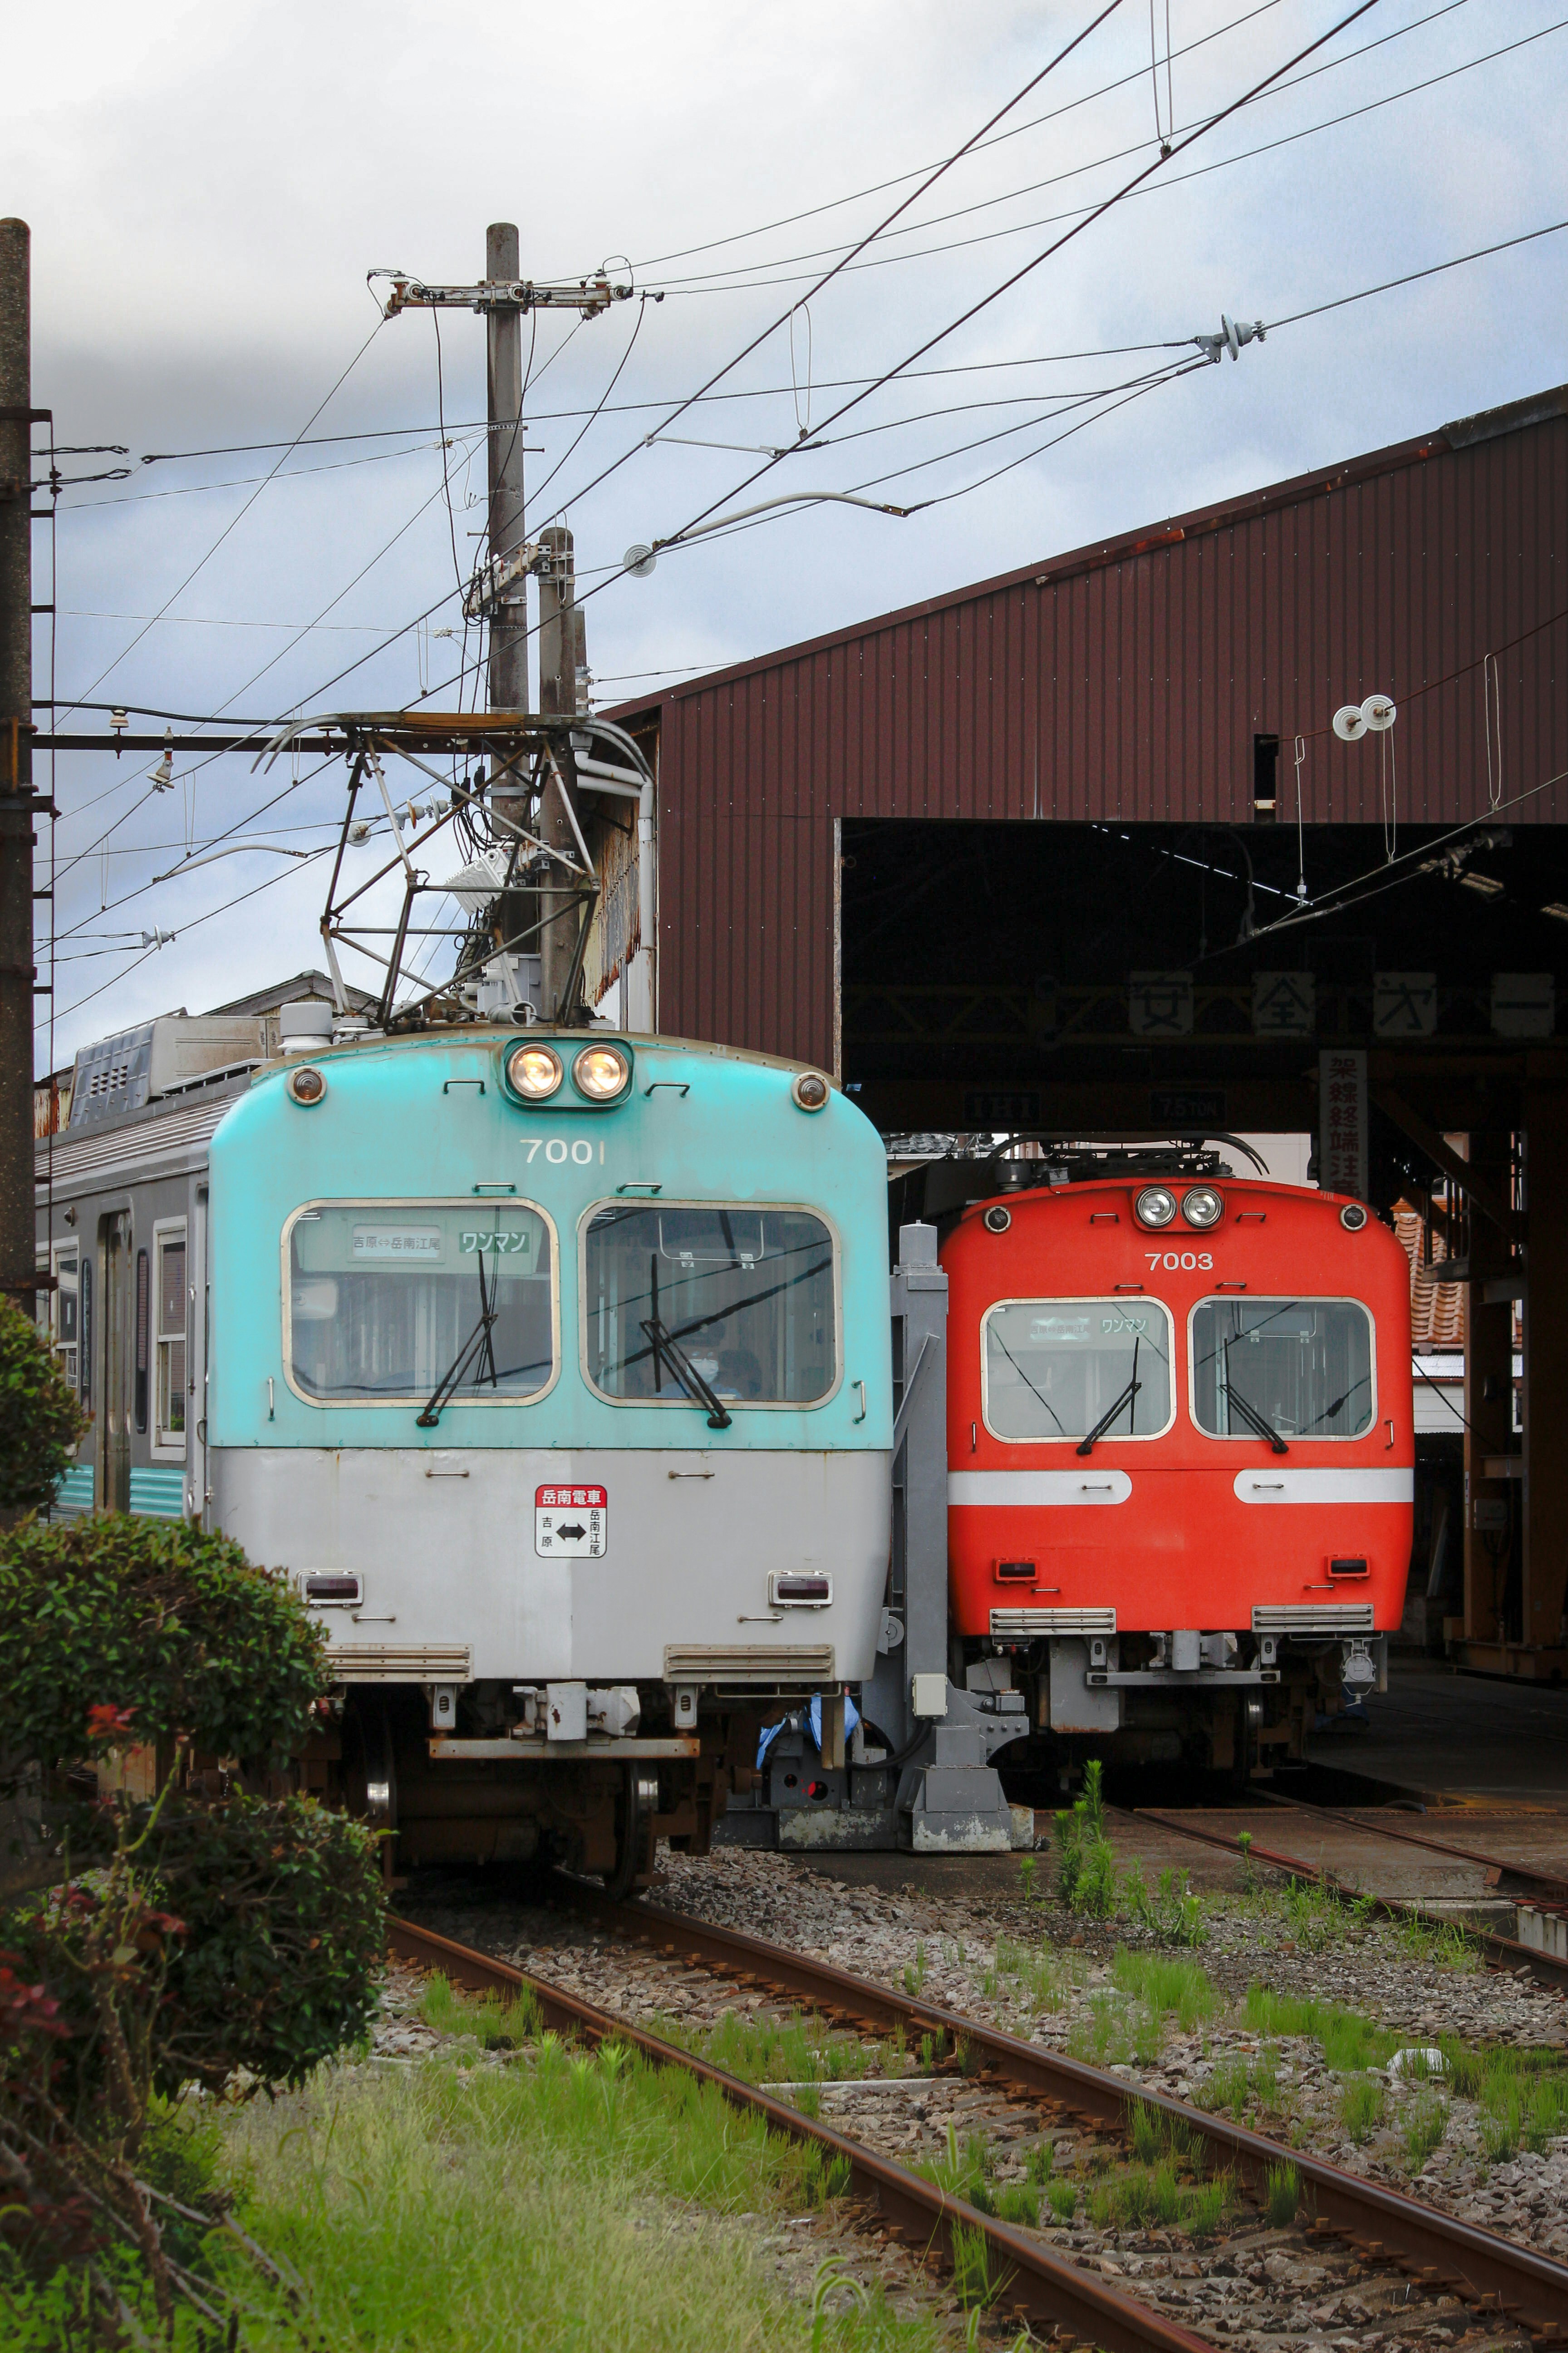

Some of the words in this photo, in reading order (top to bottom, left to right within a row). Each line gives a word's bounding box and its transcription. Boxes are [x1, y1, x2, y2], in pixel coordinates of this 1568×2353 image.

[520, 1139, 605, 1165] 7001
[353, 1236, 377, 1248] 吉原
[390, 1237, 440, 1250] 岳南江尾
[462, 1232, 526, 1253] ワンマン
[1144, 1252, 1214, 1271] 7003
[1102, 1319, 1146, 1333] ワンマン
[542, 1490, 601, 1505] 岳南電車
[541, 1516, 553, 1547] 吉原
[590, 1509, 600, 1555] 岳南江尾
